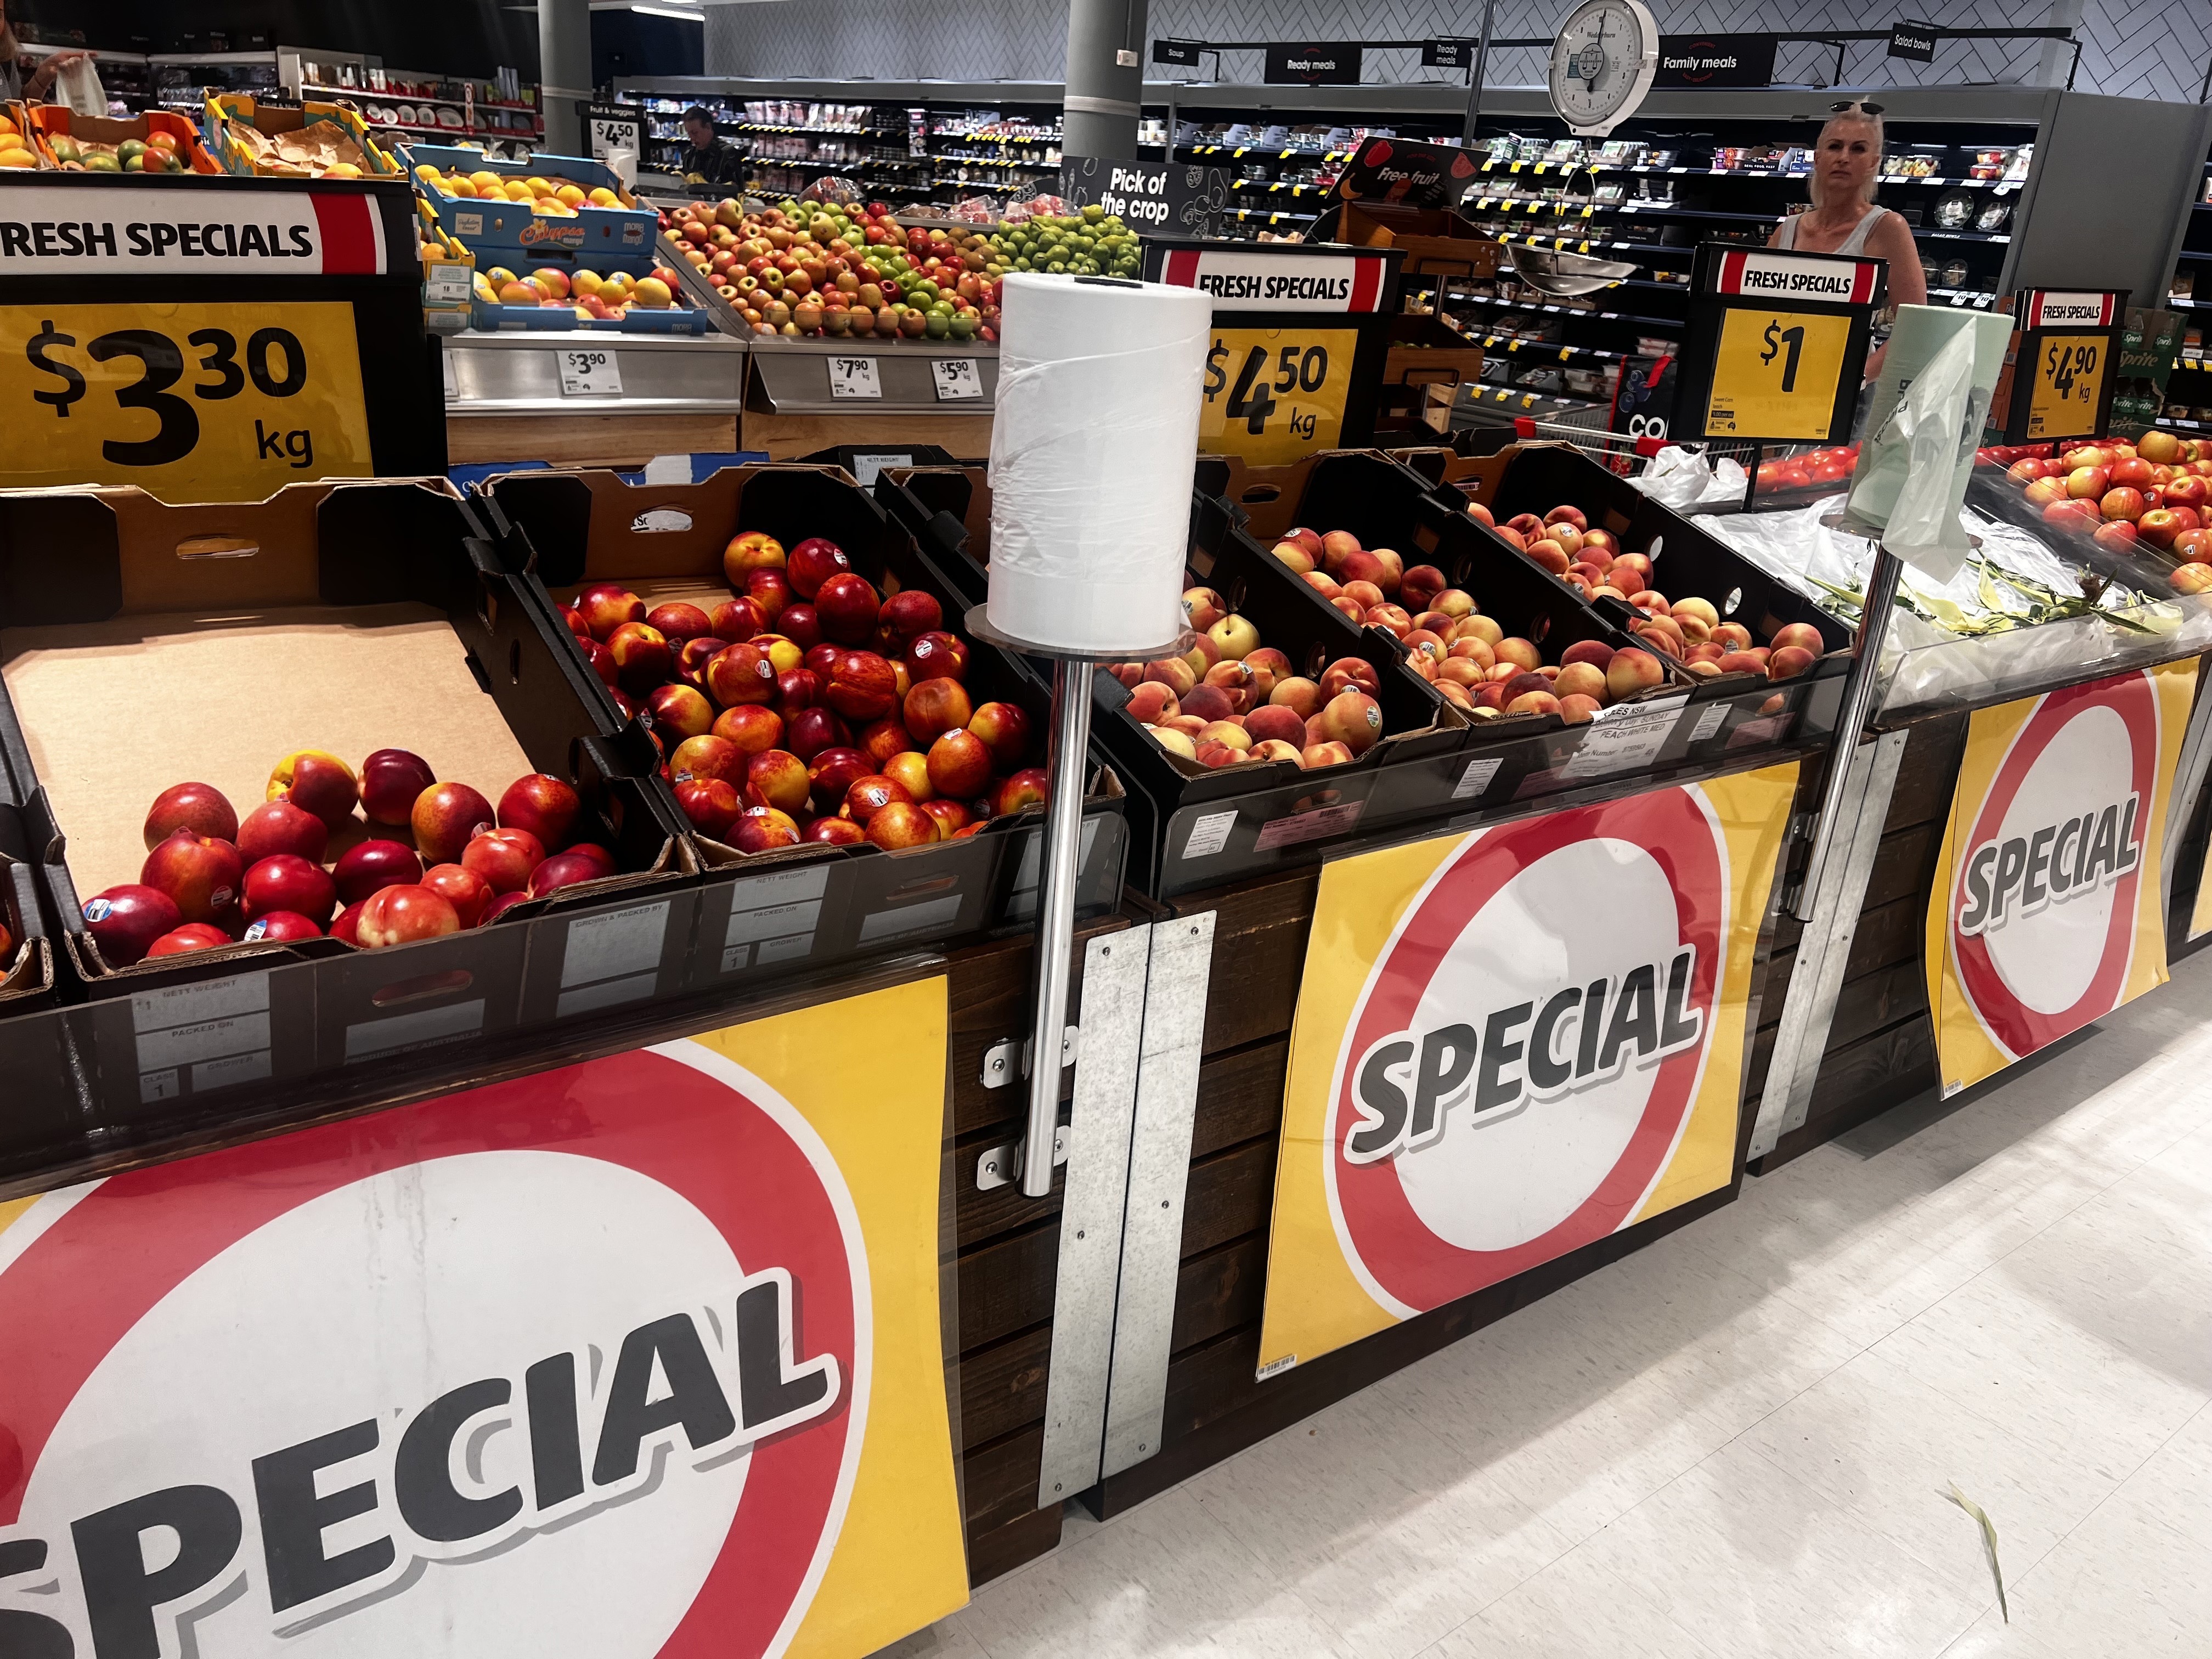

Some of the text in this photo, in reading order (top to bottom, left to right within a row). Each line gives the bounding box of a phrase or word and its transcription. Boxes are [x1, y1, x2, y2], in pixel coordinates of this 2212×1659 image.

[1894, 34, 1931, 50] Salad bowls
[1168, 48, 1184, 59] Soup
[1437, 44, 1458, 56] Ready
[1287, 59, 1336, 71] Ready meals
[1436, 56, 1456, 64] meals
[1663, 55, 1737, 71] Family meals
[590, 105, 603, 114] Fruit
[625, 140, 634, 149] kg
[1110, 168, 1167, 195] Pick of
[1377, 167, 1441, 185] Free fruit
[1101, 191, 1170, 225] the crop
[0, 222, 313, 258] RESH SPECIALS
[1199, 274, 1350, 300] FRESH SPECIALS
[1744, 270, 1852, 294] FRESH SPECIALS
[2042, 306, 2101, 319] FRESH SPECIALS
[1759, 319, 1805, 393] $1
[2119, 351, 2159, 368] Sprite
[861, 373, 870, 381] kg
[963, 373, 970, 381] kg
[2079, 382, 2091, 403] kg
[2117, 399, 2133, 408] rite
[2138, 402, 2154, 410] rite
[1289, 407, 1317, 440] kg
[254, 419, 313, 469] kg
[1629, 705, 1648, 715] NSW
[1640, 712, 1671, 724] SUNDAY
[1600, 723, 1666, 739] PEACH WHITE MED
[1962, 797, 2137, 929] SPECIAL
[757, 871, 808, 884] NETT WEIGHT
[575, 916, 607, 928] GROWN
[617, 907, 651, 918] PACKED
[753, 908, 784, 918] PACKED
[910, 921, 955, 936] AUSTRALIA
[769, 936, 802, 947] GROWER
[725, 947, 748, 956] CLASS
[730, 957, 738, 968] 1
[163, 979, 237, 998] NETT WEIGHT
[172, 1020, 234, 1038] PACKED ON
[1351, 952, 1700, 1154] SPECIAL
[207, 1056, 254, 1070] GROWER
[143, 1071, 176, 1084] CLASS
[154, 1084, 164, 1097] 1
